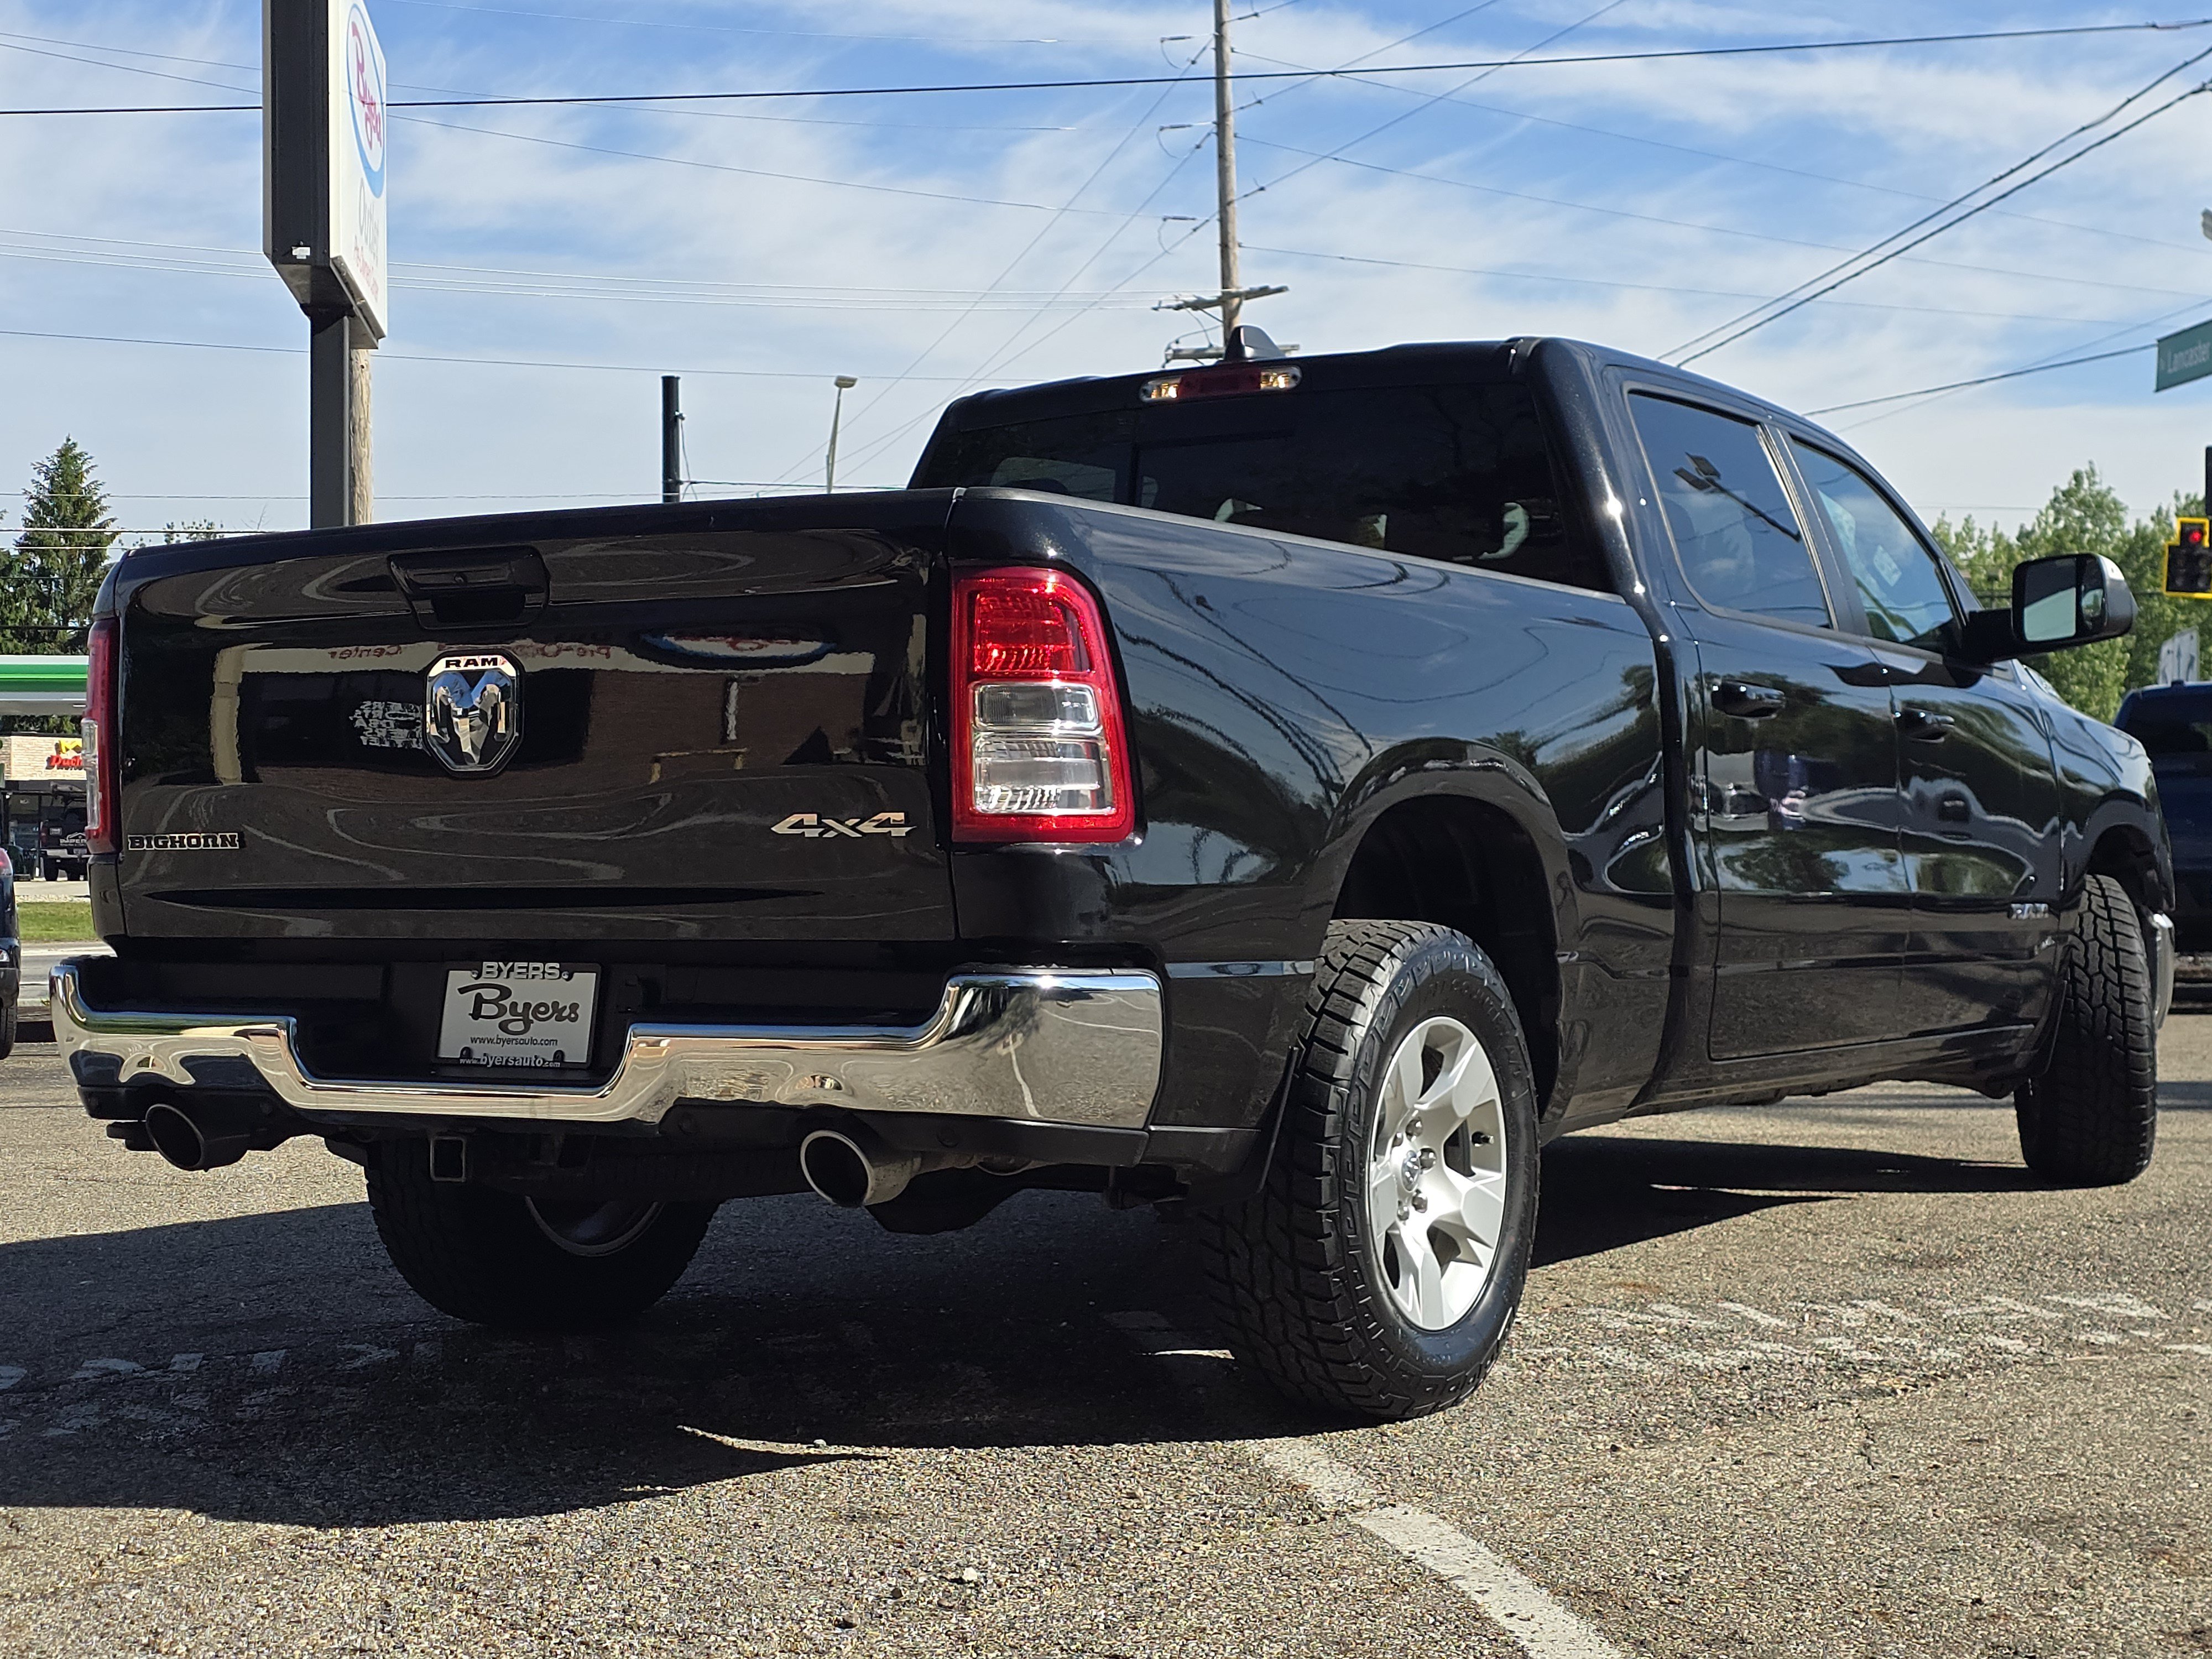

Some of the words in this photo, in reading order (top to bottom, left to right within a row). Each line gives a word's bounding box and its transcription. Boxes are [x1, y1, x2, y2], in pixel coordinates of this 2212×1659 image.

[445, 657, 499, 669] RAM
[128, 833, 239, 851] BIGHORN
[482, 961, 560, 980] BYERS
[457, 983, 580, 1036] Byers
[470, 1035, 558, 1047] www.byersauto.com
[459, 1052, 561, 1068] www.byersauto.com
